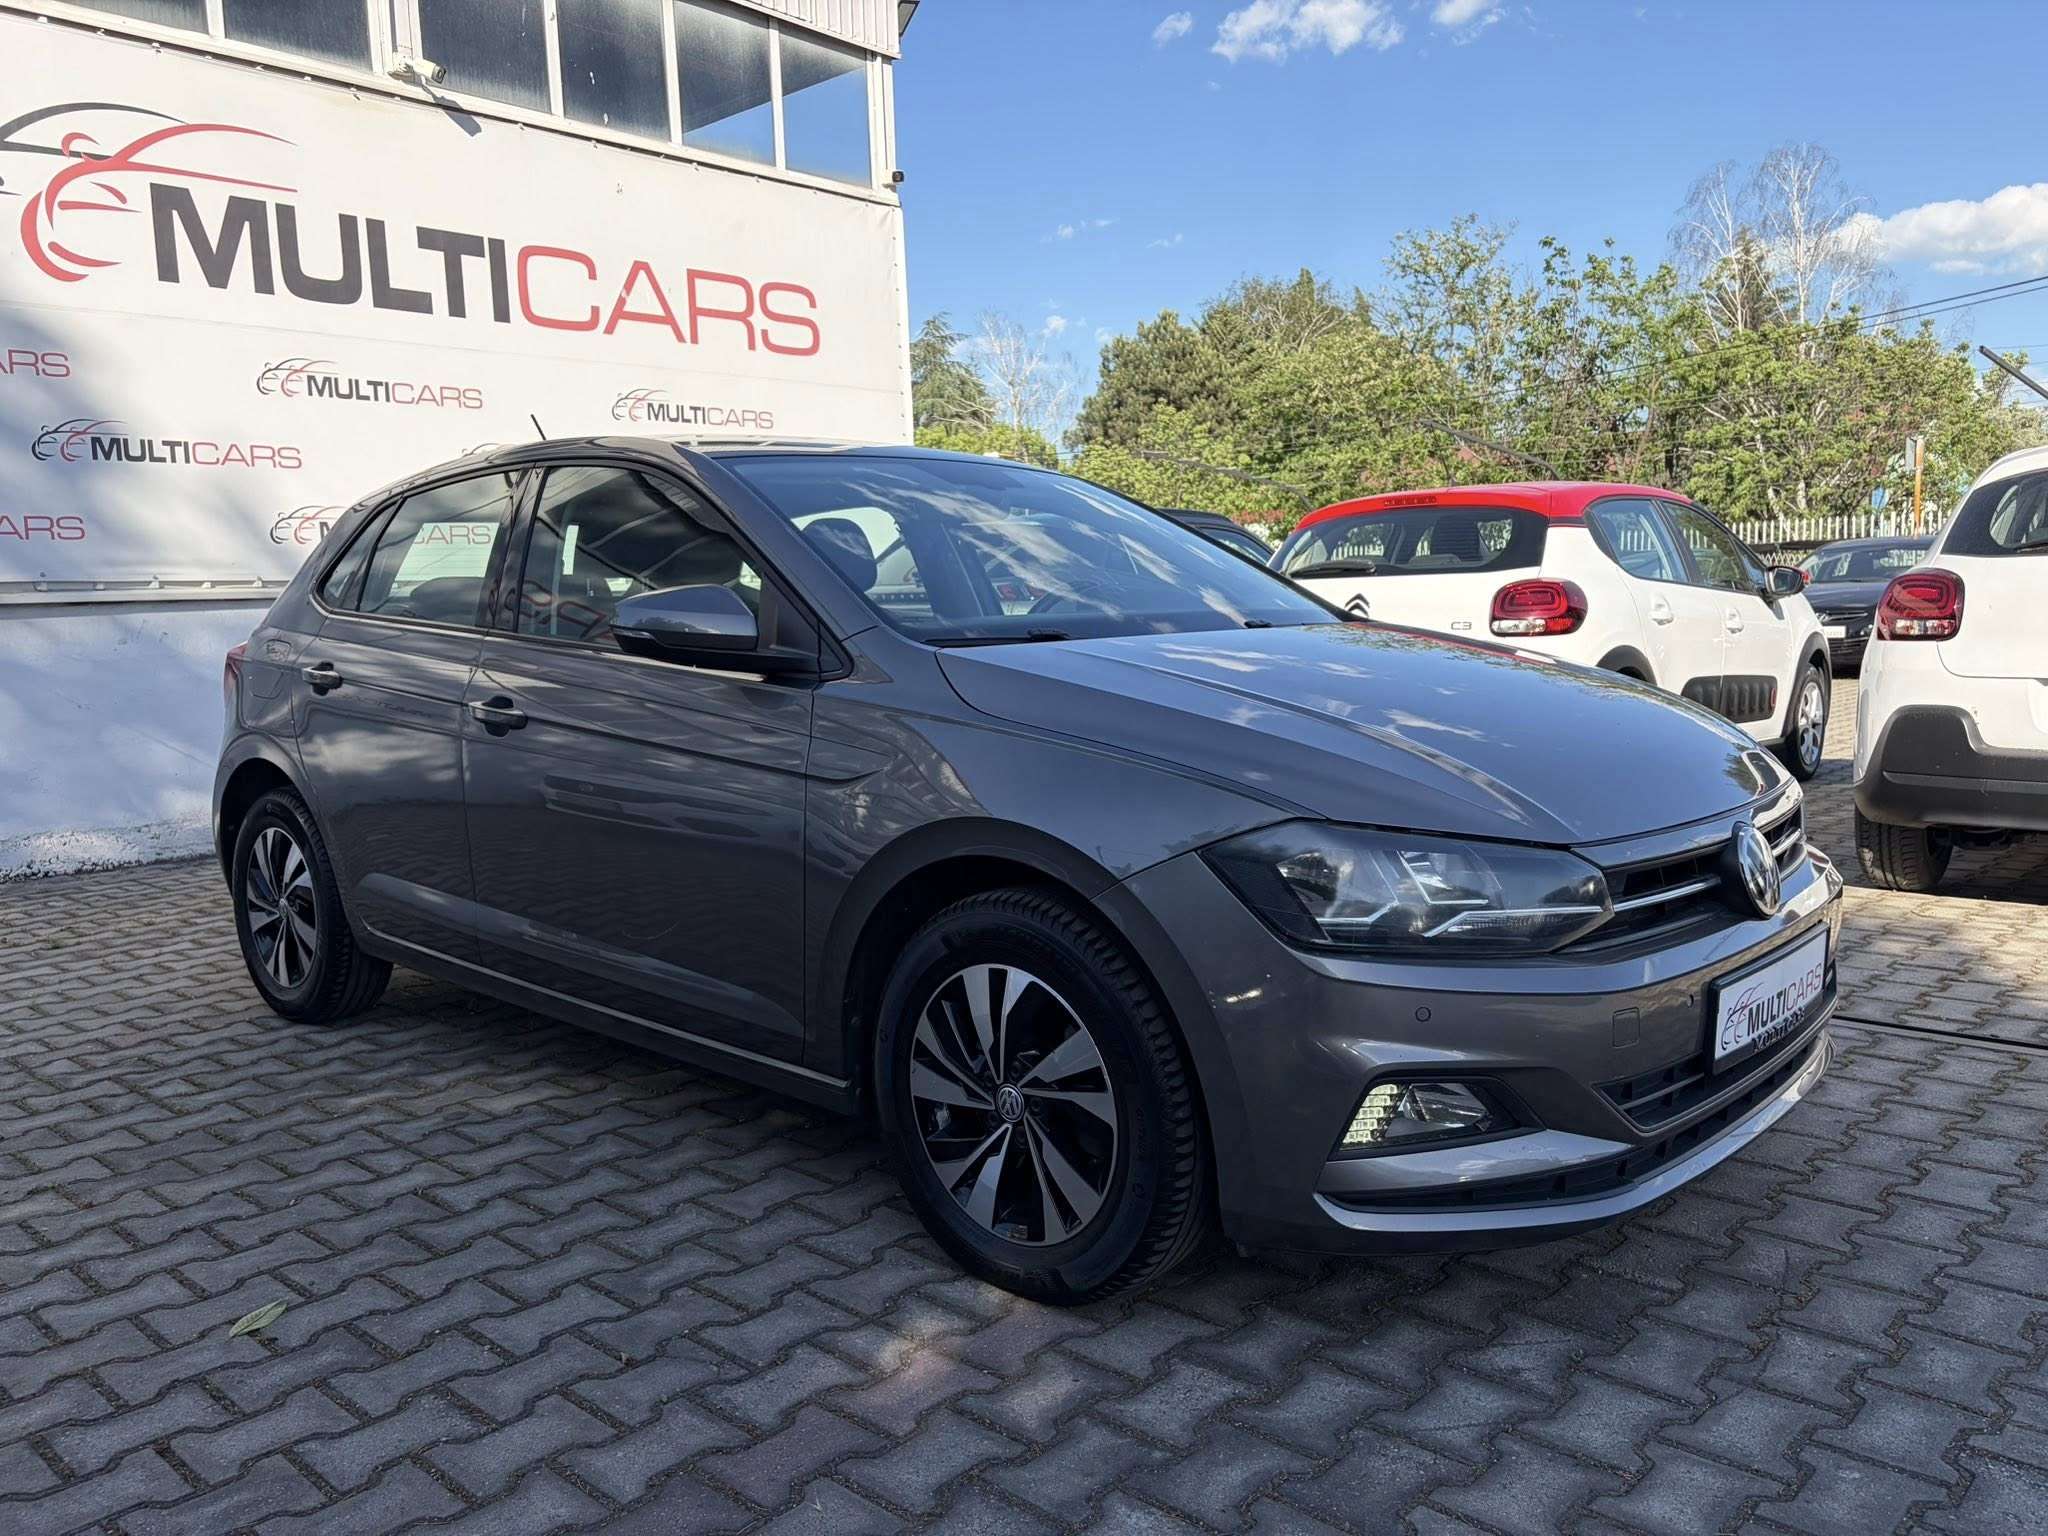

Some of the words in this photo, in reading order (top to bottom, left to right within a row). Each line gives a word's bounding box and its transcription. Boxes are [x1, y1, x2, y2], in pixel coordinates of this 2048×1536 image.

[150, 182, 821, 357] MULTICARS
[0, 349, 71, 377] RS
[306, 374, 483, 409] MULTICARS
[647, 402, 774, 430] MULTICARS
[90, 436, 302, 469] MULTICARS
[1451, 621, 1472, 630] C3
[1747, 962, 1822, 1037] MULTICARS
